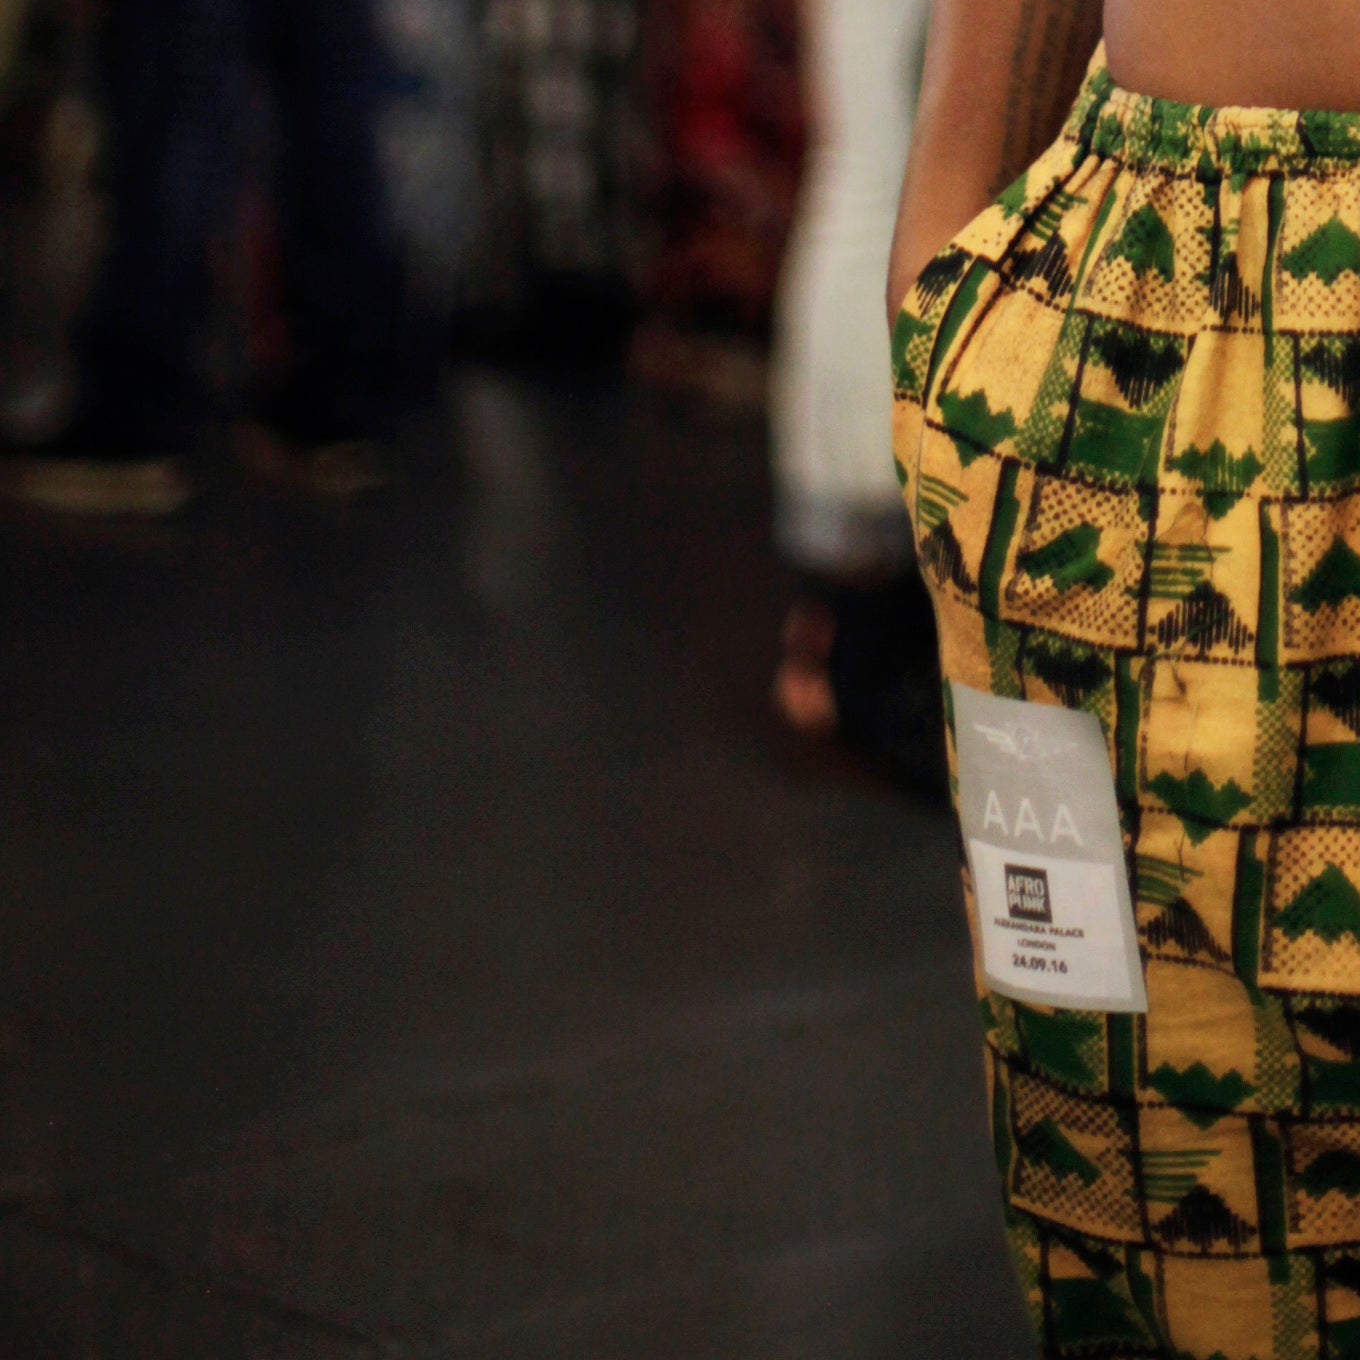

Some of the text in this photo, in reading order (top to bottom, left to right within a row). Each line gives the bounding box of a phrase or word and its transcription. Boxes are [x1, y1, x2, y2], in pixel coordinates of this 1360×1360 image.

[983, 789, 1085, 848] AAA
[1008, 873, 1044, 897] AFRO
[1008, 892, 1047, 914] PUNK
[1017, 938, 1057, 952] LONDON
[1012, 952, 1068, 974] 24.09.16
